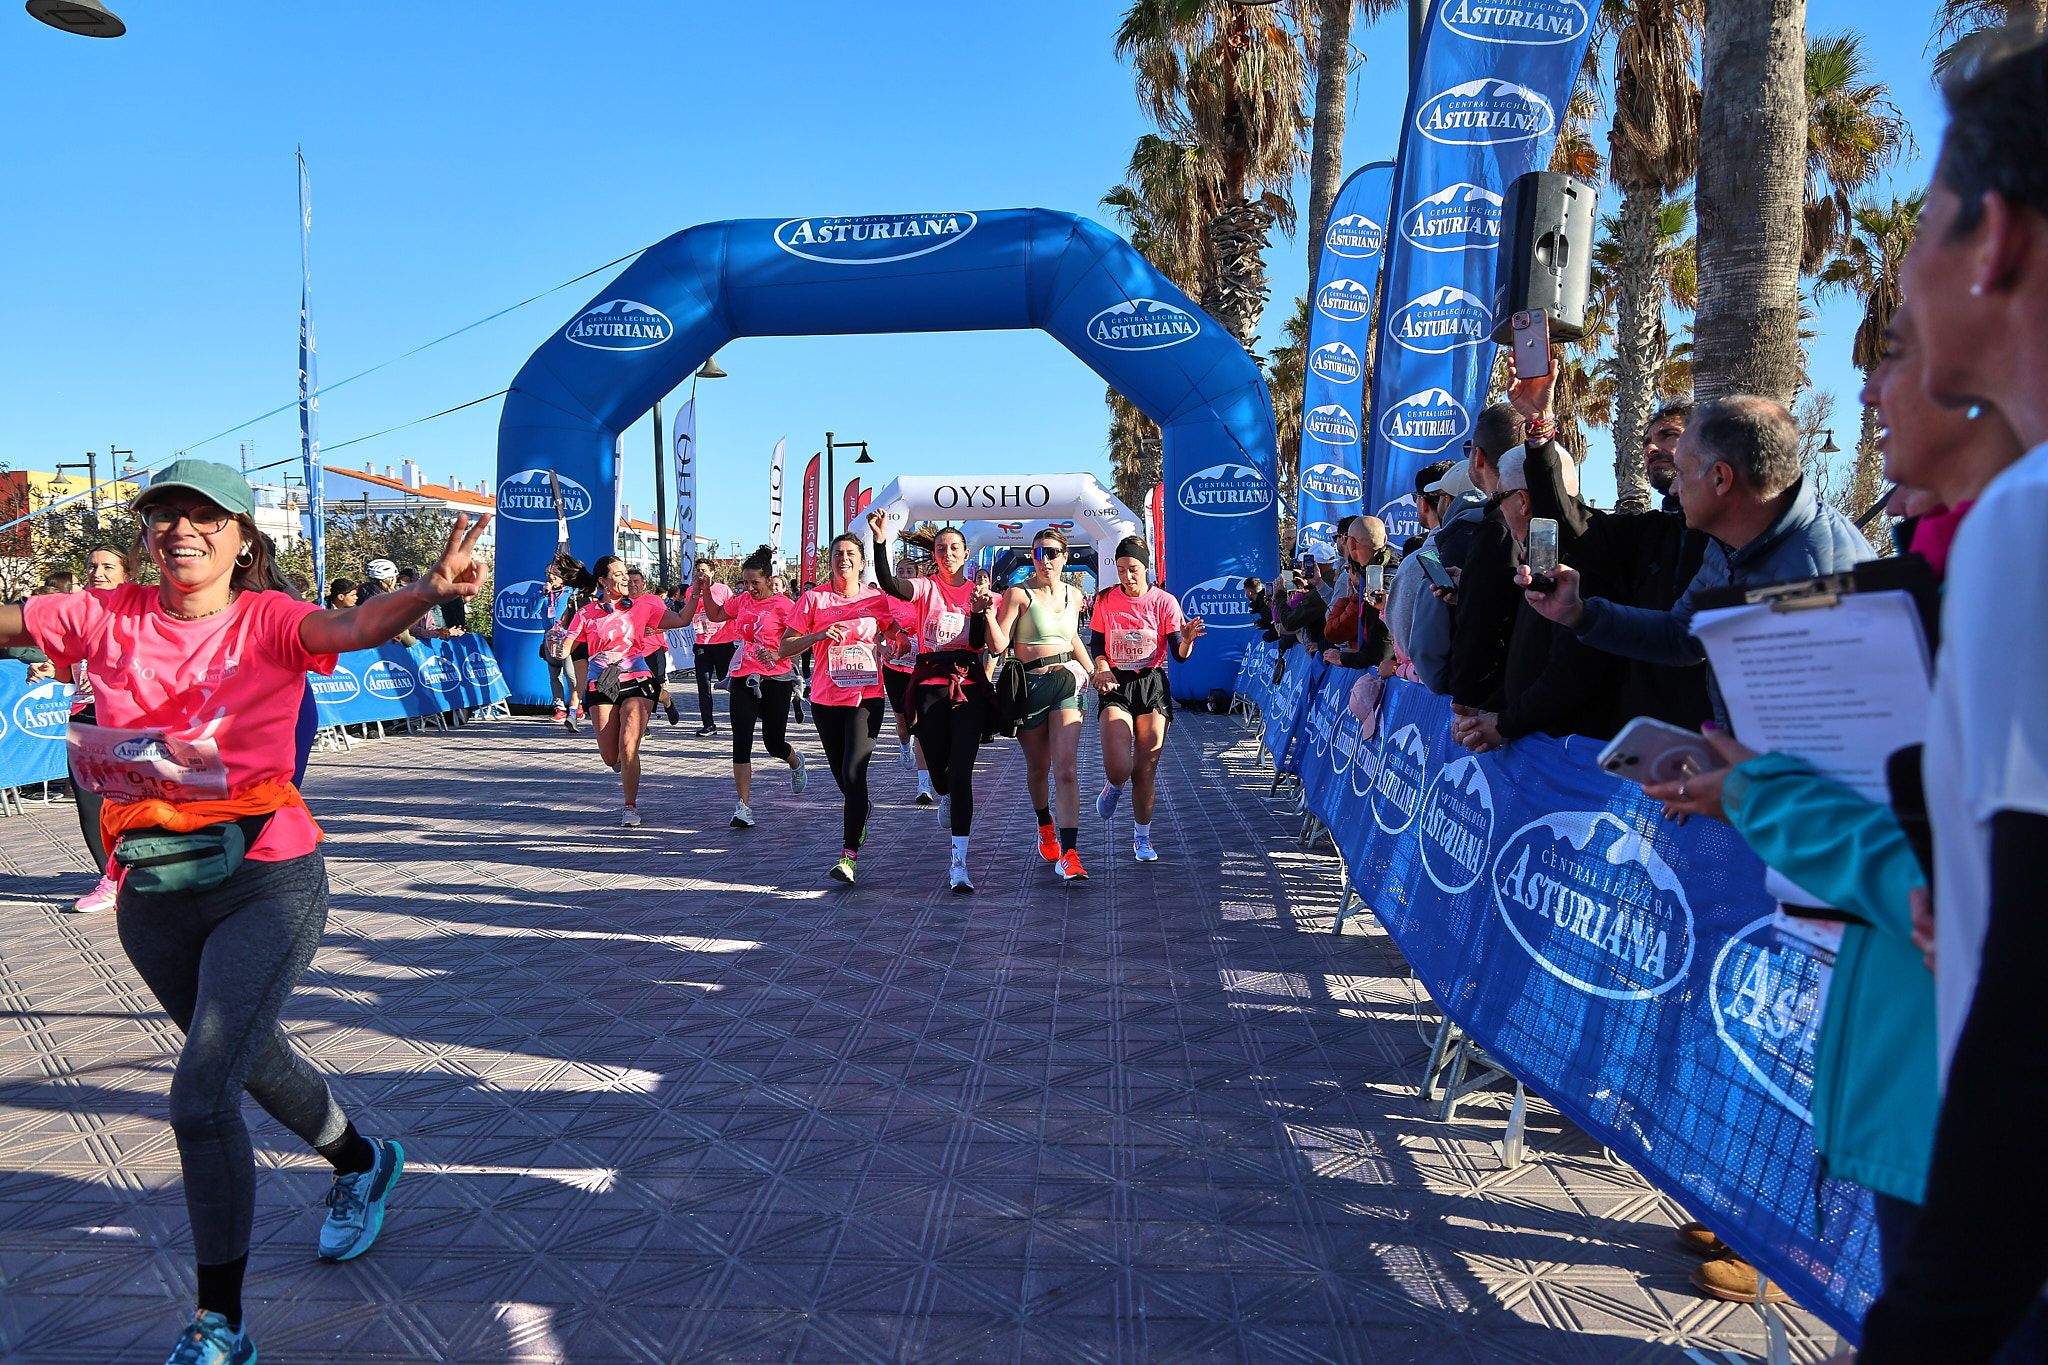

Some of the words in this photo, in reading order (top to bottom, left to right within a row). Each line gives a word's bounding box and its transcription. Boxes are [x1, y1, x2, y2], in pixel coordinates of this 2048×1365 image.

[1449, 0, 1573, 35] ASTURIANA
[1425, 104, 1539, 132] ASTURIANA
[1465, 206, 1502, 215] LECHER
[788, 217, 961, 245] ASTURIANA
[1410, 211, 1499, 237] ASTURIAN
[1329, 228, 1379, 248] ASTURIANA
[1321, 291, 1367, 313] ASTURIANA
[570, 320, 665, 339] ASTURIANA
[1096, 320, 1194, 340] ASTURIANA
[933, 484, 1050, 509] OYSHO
[1185, 485, 1269, 505] ASTURIANA
[807, 476, 815, 540] Santander
[1083, 508, 1119, 517] OYSHO
[668, 628, 695, 649] OYSH
[939, 630, 956, 639] 016
[1126, 647, 1143, 655] 016
[846, 662, 864, 671] 016
[311, 681, 358, 695] STURIANA
[127, 770, 180, 791] 016
[1541, 849, 1598, 886] CENTRAL
[1603, 875, 1674, 920] LECHERA
[1501, 844, 1668, 980] ASTURIANA
